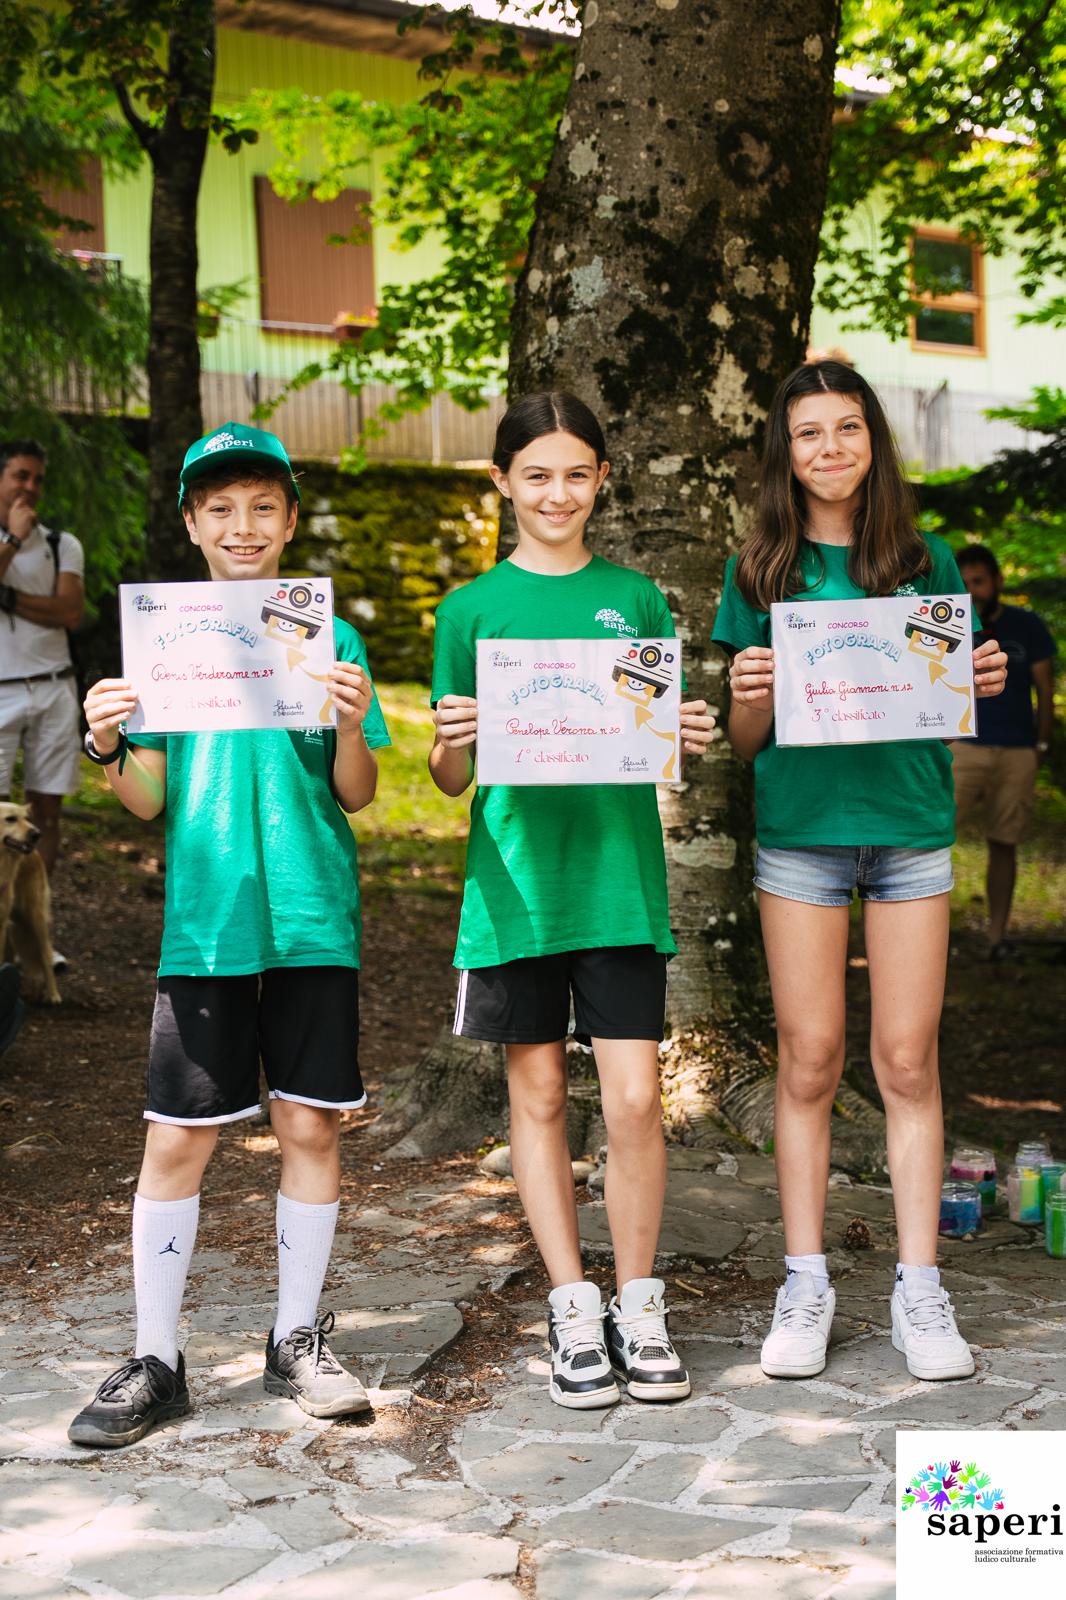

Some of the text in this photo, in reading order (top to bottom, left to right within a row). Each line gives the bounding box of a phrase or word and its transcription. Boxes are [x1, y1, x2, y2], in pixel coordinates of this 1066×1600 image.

[137, 603, 167, 612] saperi
[179, 604, 223, 612] CONCORSO
[603, 620, 638, 637] saperi
[788, 620, 816, 630] saperi
[827, 621, 869, 630] CONCORSO
[803, 633, 902, 666] FOTOGRAFIA
[493, 659, 522, 668] saperi
[533, 662, 576, 670] CONCORSO
[508, 674, 608, 705] FOTOGRAFIA
[805, 681, 836, 704] Giulia
[839, 681, 889, 701] Giannoni
[812, 708, 886, 722] 3° classificato
[506, 717, 550, 739] Penelope
[552, 715, 597, 735] Verona
[515, 748, 588, 763] 1° classificato
